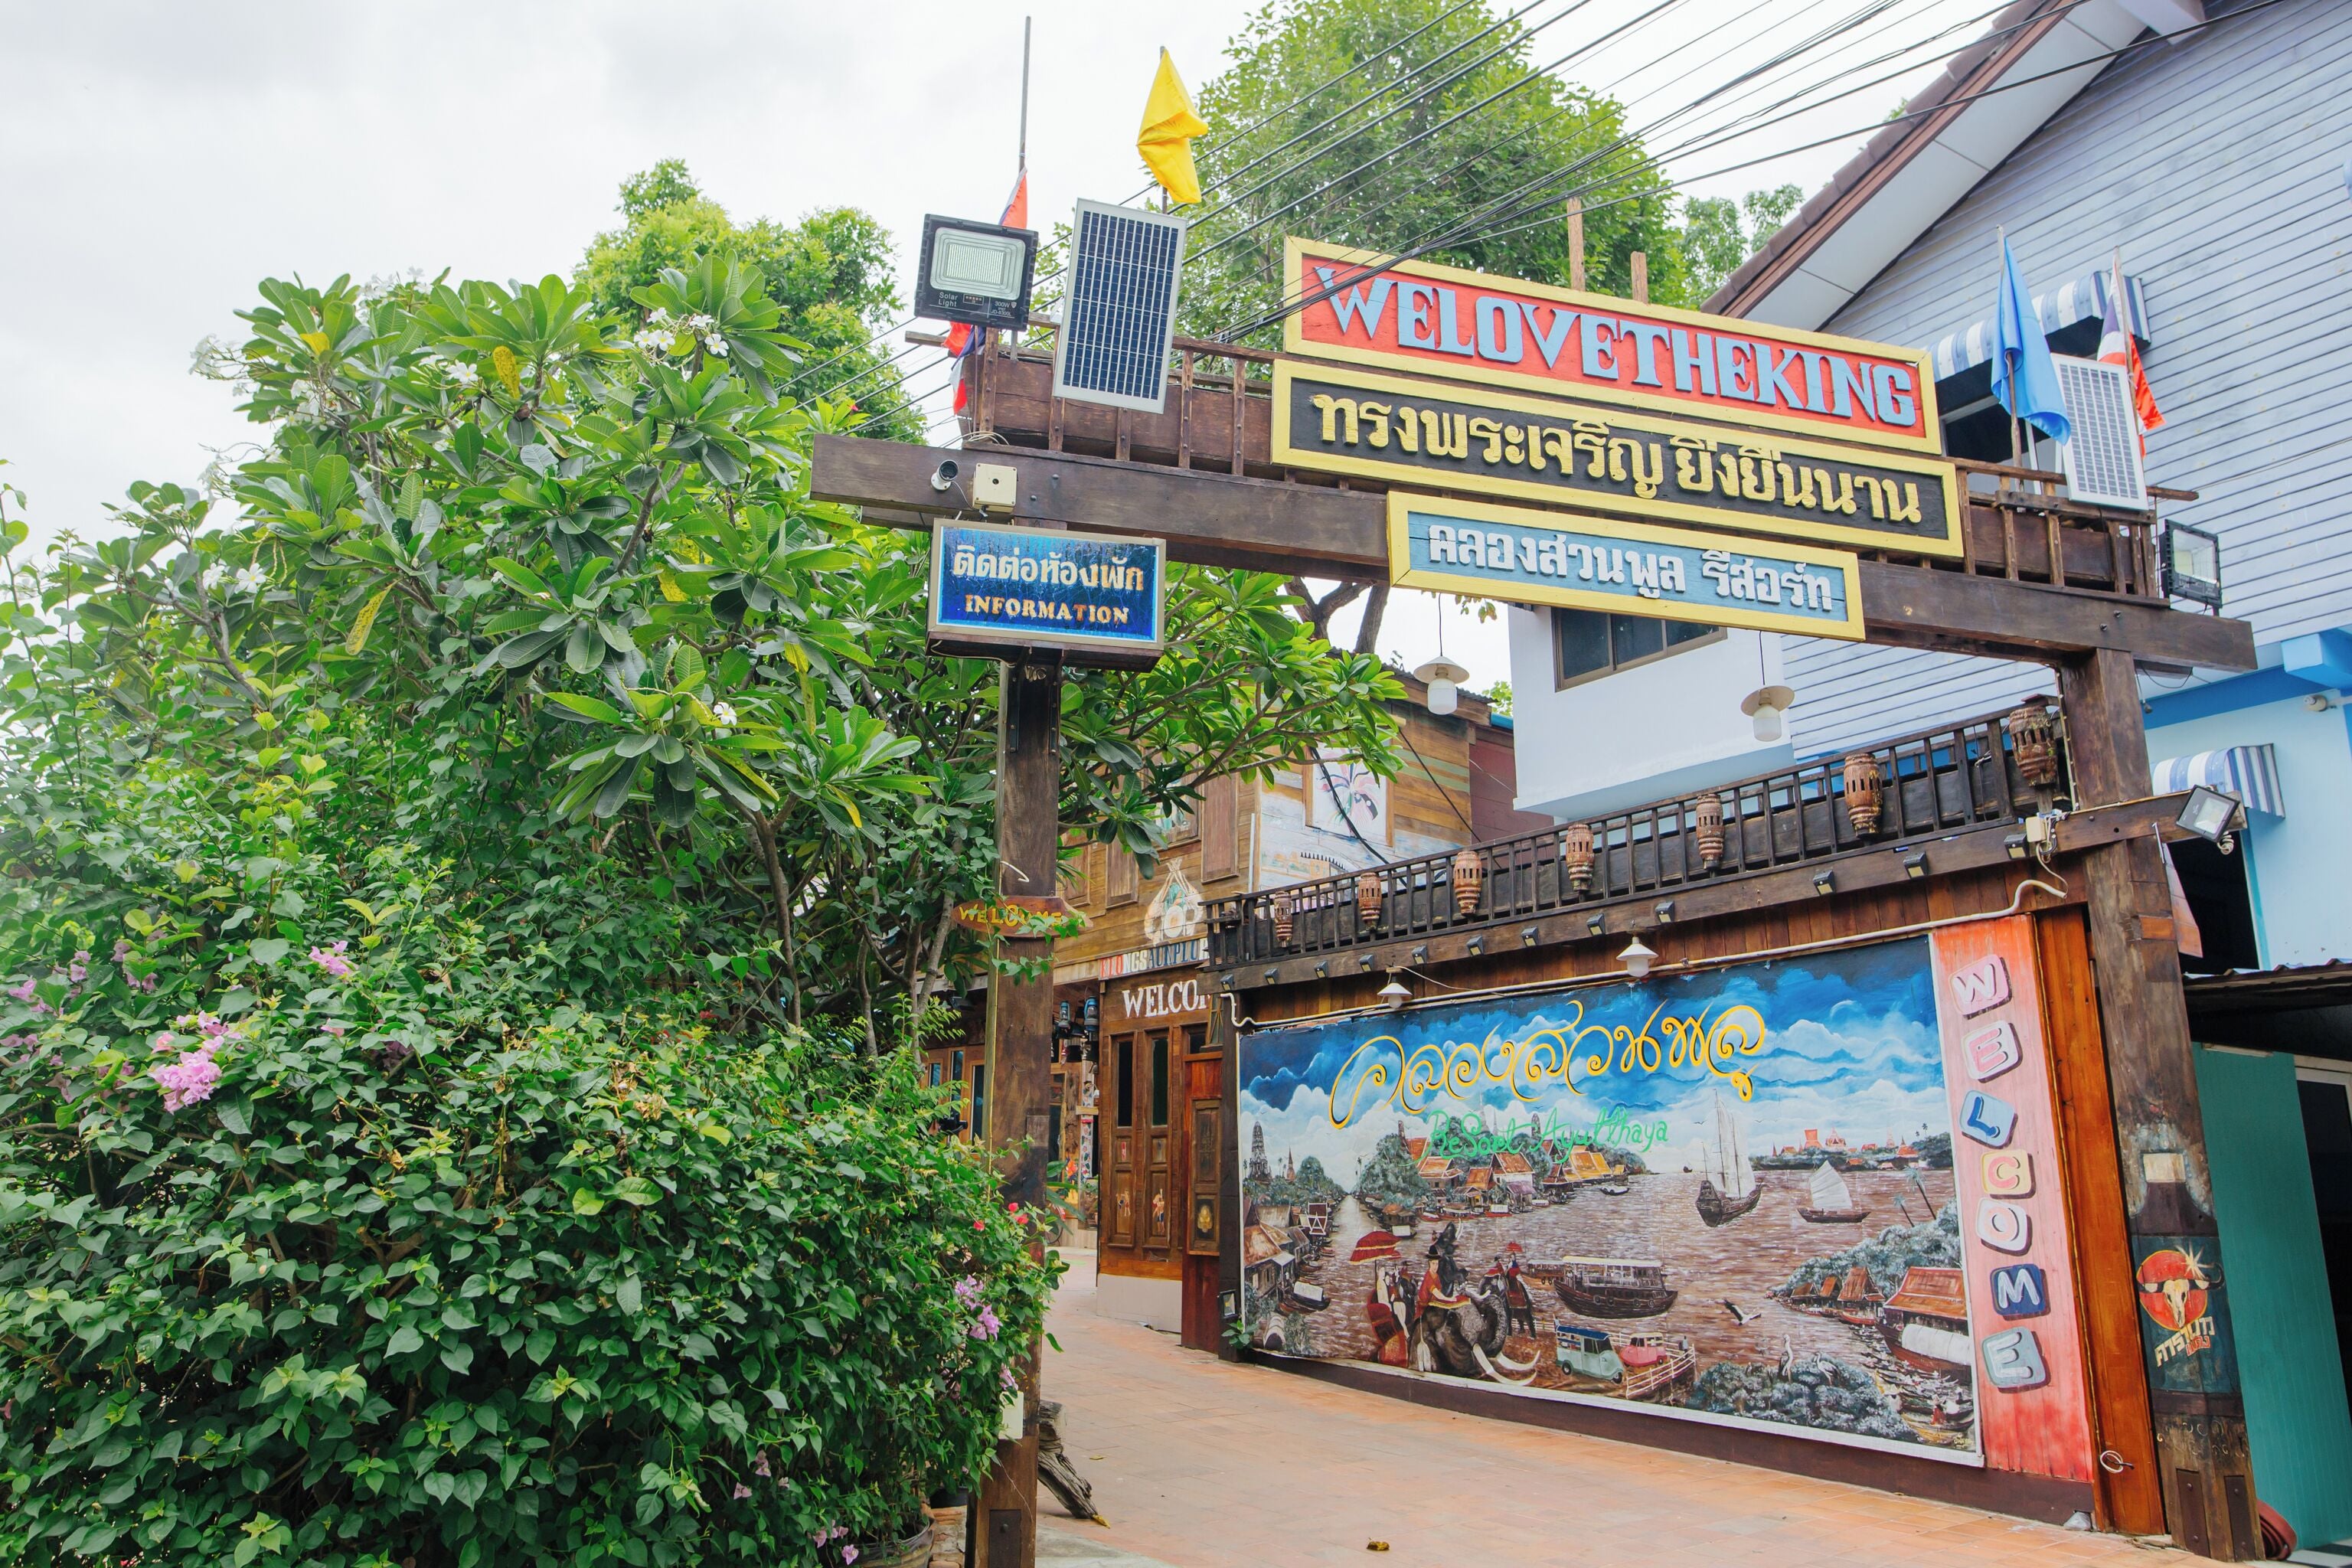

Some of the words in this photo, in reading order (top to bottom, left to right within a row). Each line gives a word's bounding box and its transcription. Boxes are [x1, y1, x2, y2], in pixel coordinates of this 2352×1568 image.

[938, 299, 957, 308] Light
[939, 292, 959, 301] Solar
[1310, 393, 1664, 499] ทรงพระเจริญ
[1670, 435, 1922, 524] ยิ่งยืนนาน
[952, 544, 1144, 591] ติดต่อห้องพัก
[1701, 550, 1832, 612] รีสอร์ท
[965, 594, 1129, 625] INFORMATION
[1531, 1106, 1669, 1165] Ayutthaya
[1953, 962, 2043, 1379] WELCOME
[2154, 1316, 2216, 1367] คาราบาว
